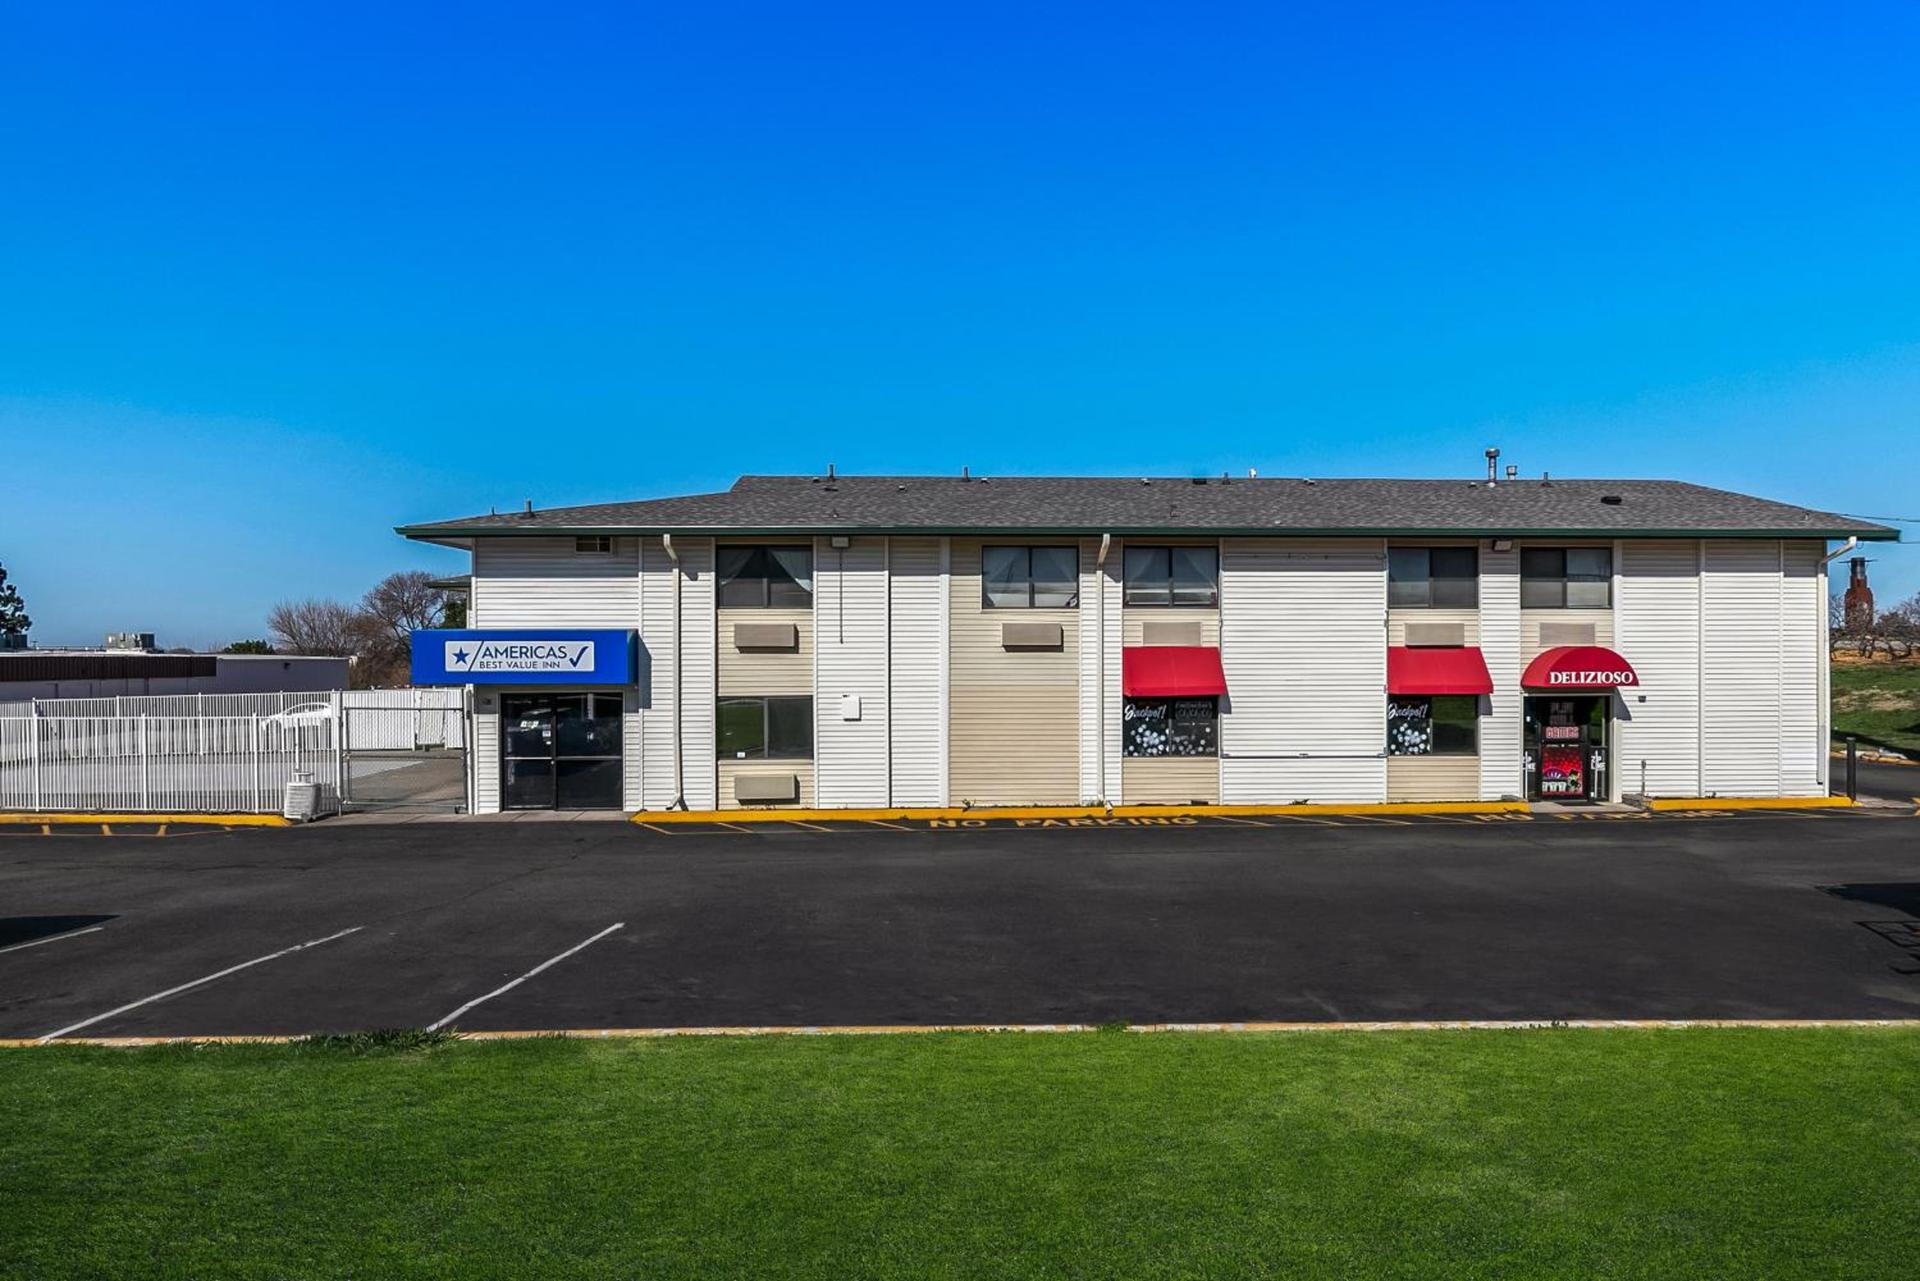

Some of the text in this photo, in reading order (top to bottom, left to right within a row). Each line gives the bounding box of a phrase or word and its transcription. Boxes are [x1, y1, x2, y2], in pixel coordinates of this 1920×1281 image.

[481, 645, 568, 660] AMERICAS
[479, 661, 561, 669] BEST VALUE INN
[1549, 671, 1634, 684] DELIZIOSO
[928, 816, 1200, 828] NO PARKING
